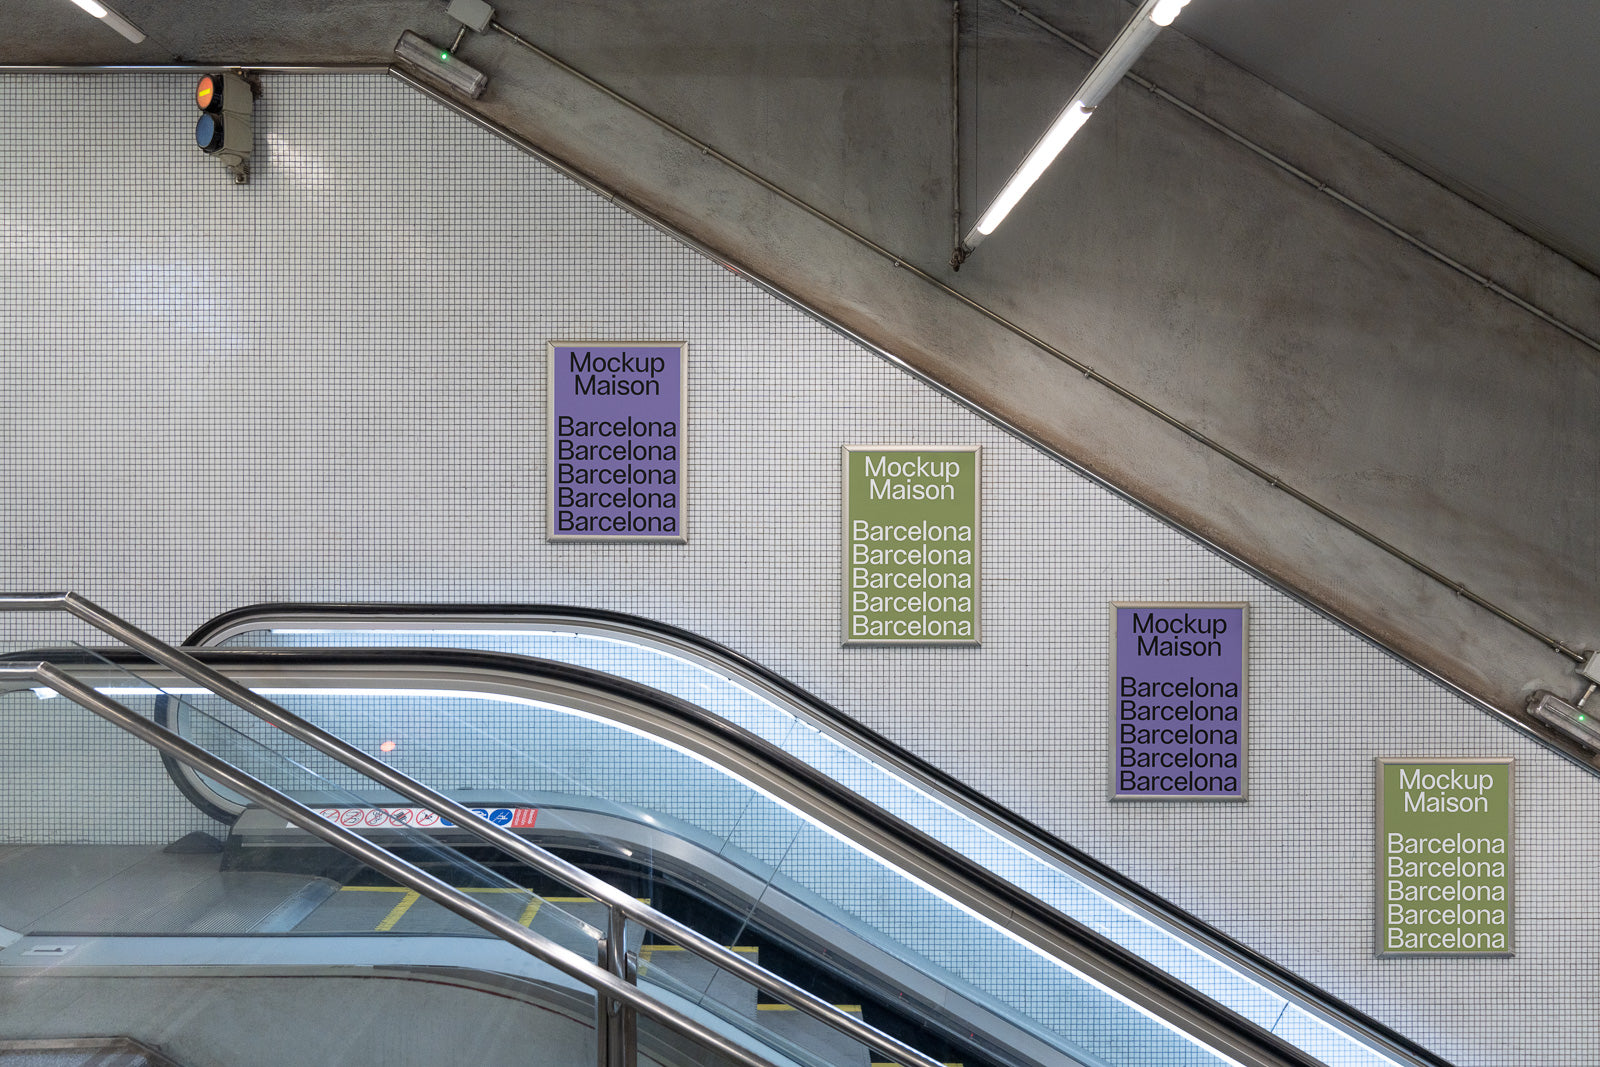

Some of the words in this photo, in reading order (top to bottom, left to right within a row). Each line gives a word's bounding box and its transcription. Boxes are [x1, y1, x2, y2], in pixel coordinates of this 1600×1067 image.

[570, 351, 665, 379] Mockup
[574, 374, 660, 396] Maison
[558, 415, 677, 438] Barcelona
[558, 439, 677, 462] Barcelona
[558, 462, 677, 485] Barcelona
[864, 455, 960, 483] Mockup
[558, 486, 677, 509] Barcelona
[869, 478, 955, 501] Maison
[558, 510, 677, 533] Barcelona
[852, 519, 972, 542] Barcelona
[852, 543, 972, 566] Barcelona
[852, 567, 972, 589] Barcelona
[852, 590, 972, 613] Barcelona
[852, 614, 972, 637] Barcelona
[1132, 612, 1228, 640] Mockup
[1137, 635, 1222, 657] Maison
[1120, 676, 1239, 698] Barcelona
[1120, 699, 1239, 722] Barcelona
[1120, 723, 1238, 745] Barcelona
[1120, 746, 1238, 769] Barcelona
[1120, 769, 1238, 792] Barcelona
[1399, 768, 1494, 796] Mockup
[1404, 791, 1488, 813] Maison
[1387, 832, 1505, 854] Barcelona
[1387, 856, 1505, 878] Barcelona
[1387, 879, 1505, 902] Barcelona
[1387, 903, 1505, 925] Barcelona
[1387, 927, 1505, 949] Barcelona
